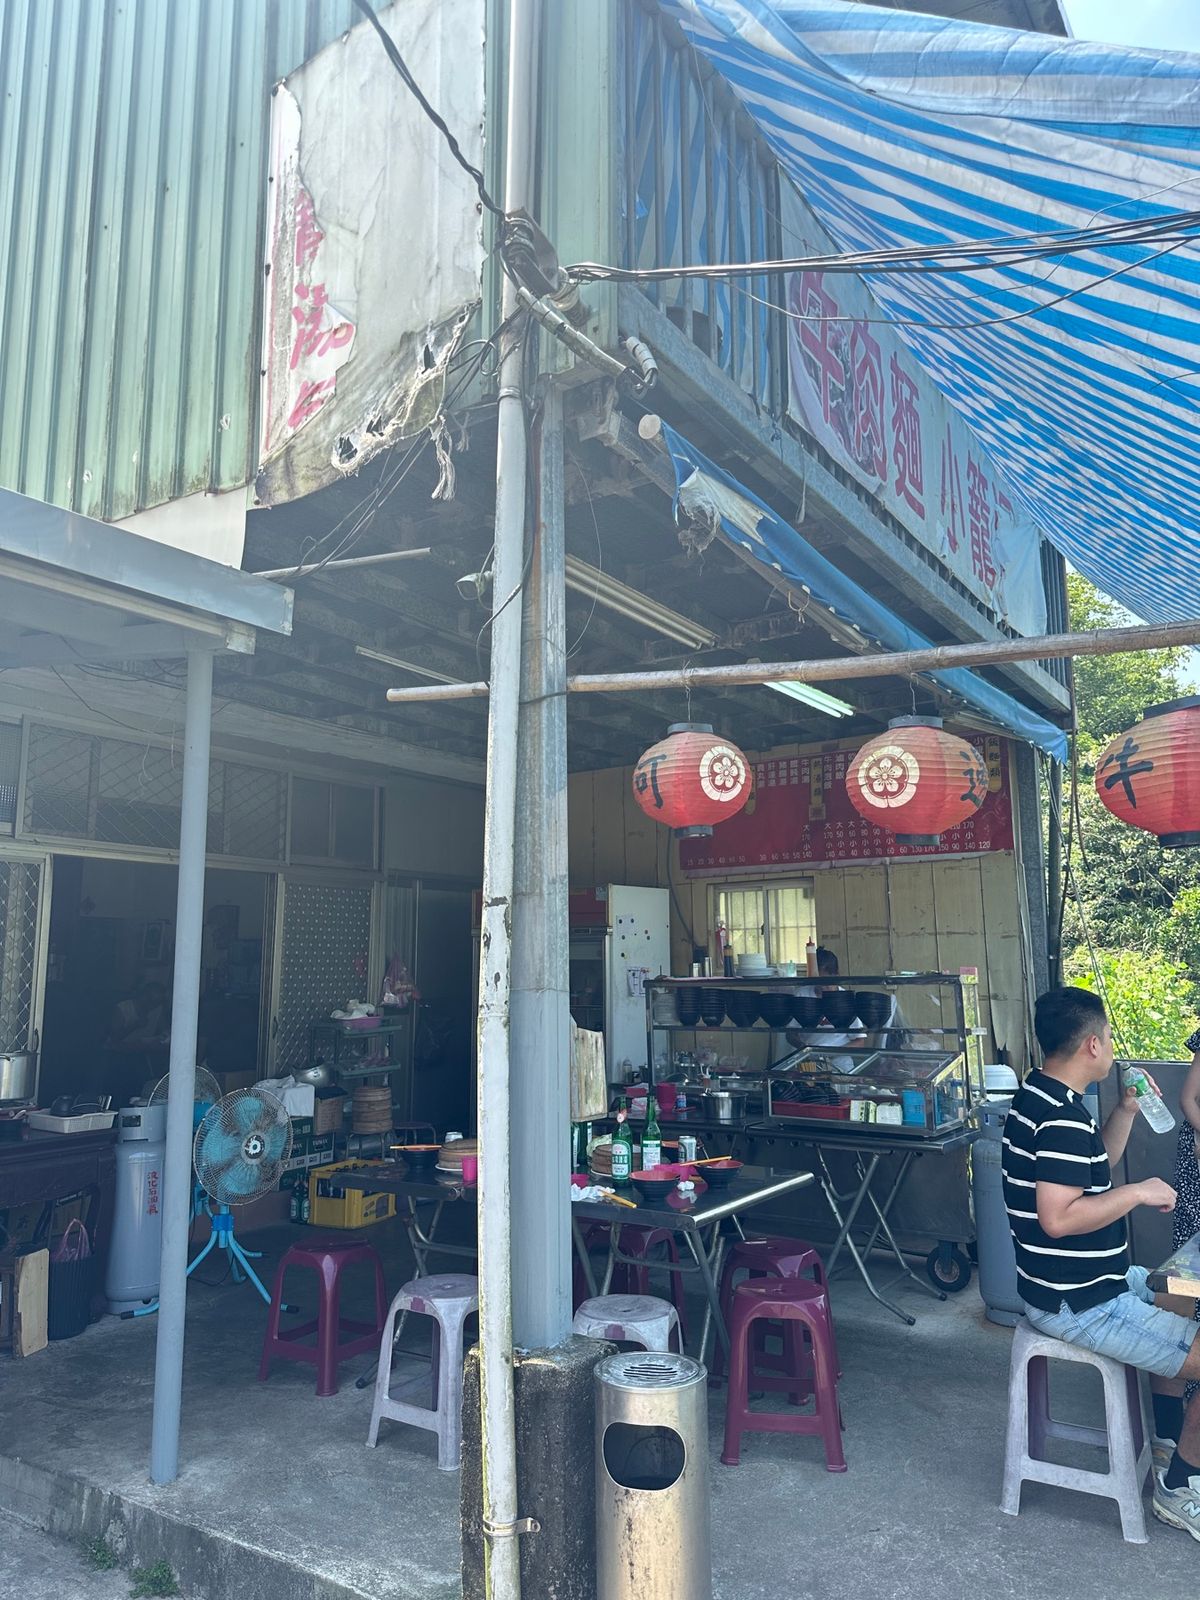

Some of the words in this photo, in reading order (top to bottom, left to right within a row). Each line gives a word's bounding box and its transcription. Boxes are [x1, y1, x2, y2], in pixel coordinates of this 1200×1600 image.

[796, 271, 925, 520] 牛肉麵
[963, 821, 975, 829] 170
[951, 842, 960, 850] 90
[965, 841, 976, 850] 140
[978, 840, 991, 849] 120
[899, 846, 908, 854] 60
